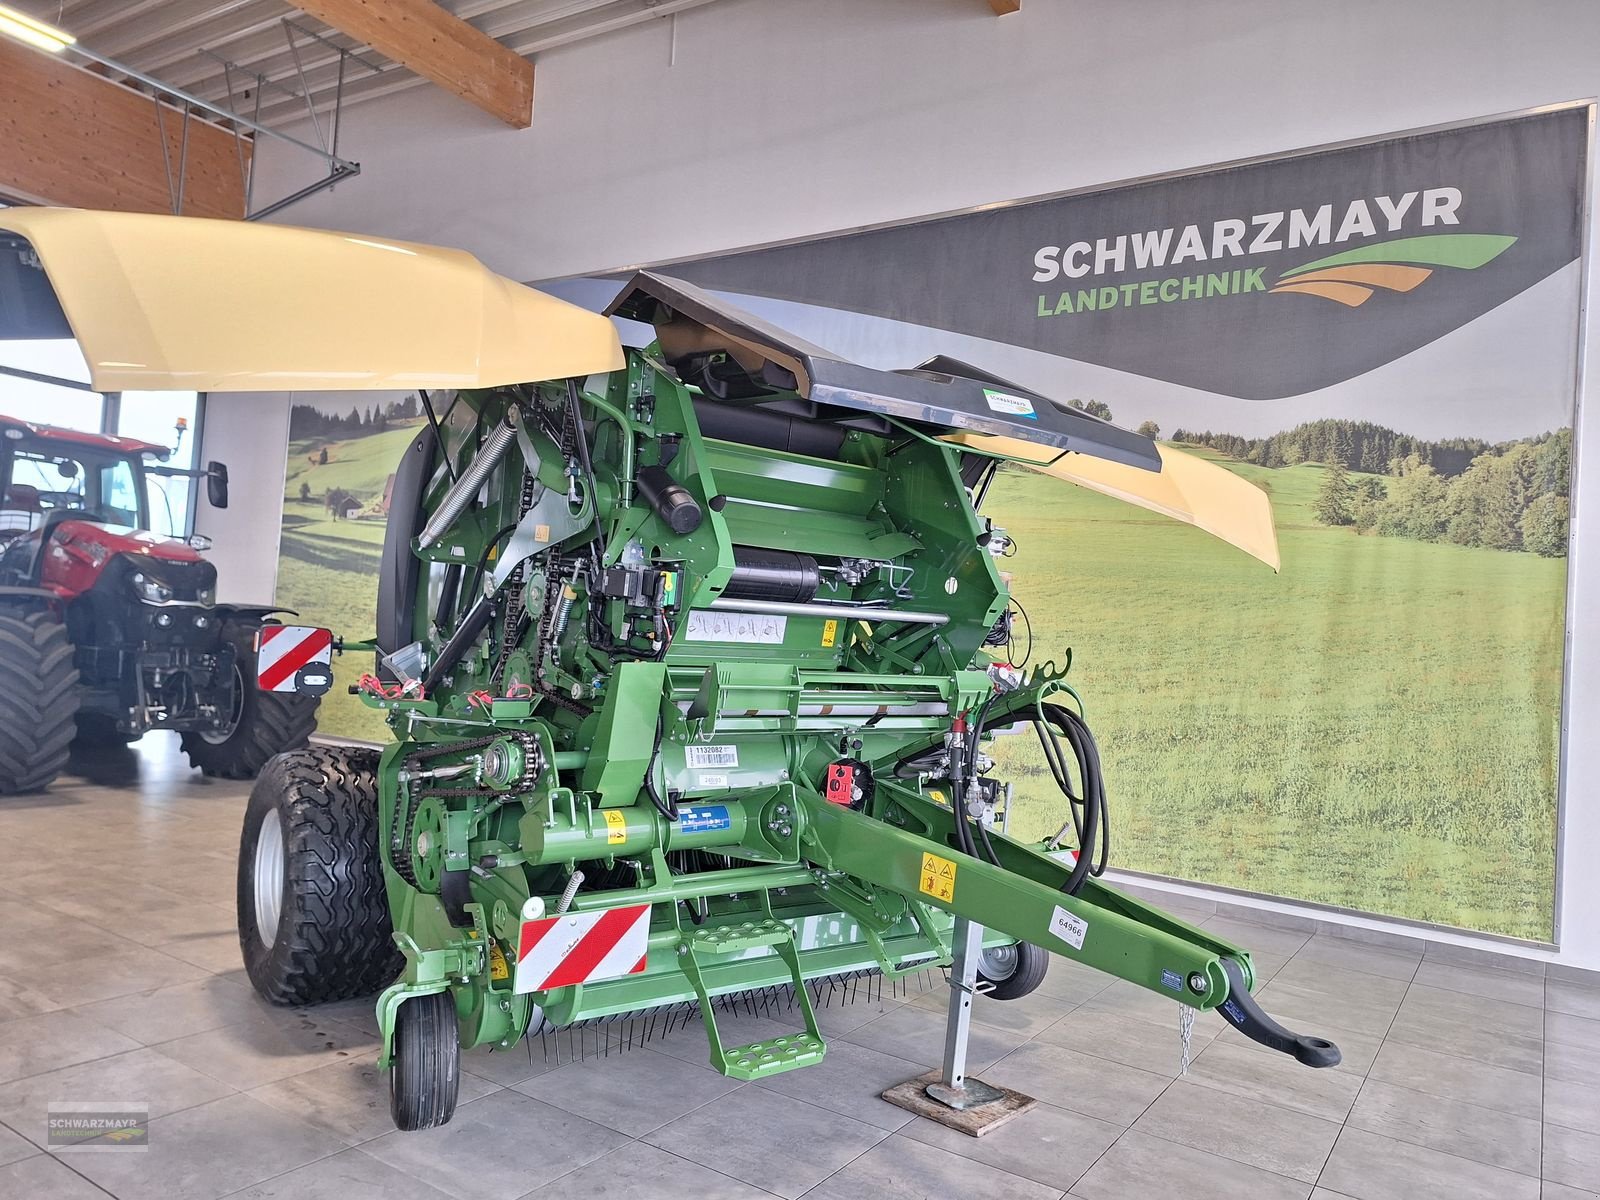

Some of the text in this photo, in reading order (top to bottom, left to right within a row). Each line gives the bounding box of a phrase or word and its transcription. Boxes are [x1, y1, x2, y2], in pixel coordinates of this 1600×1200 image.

[1032, 187, 1463, 283] SCHWARZMAYR
[1037, 266, 1267, 317] LANDTECHNIK
[696, 746, 723, 754] 1132082
[1058, 918, 1082, 937] 64966
